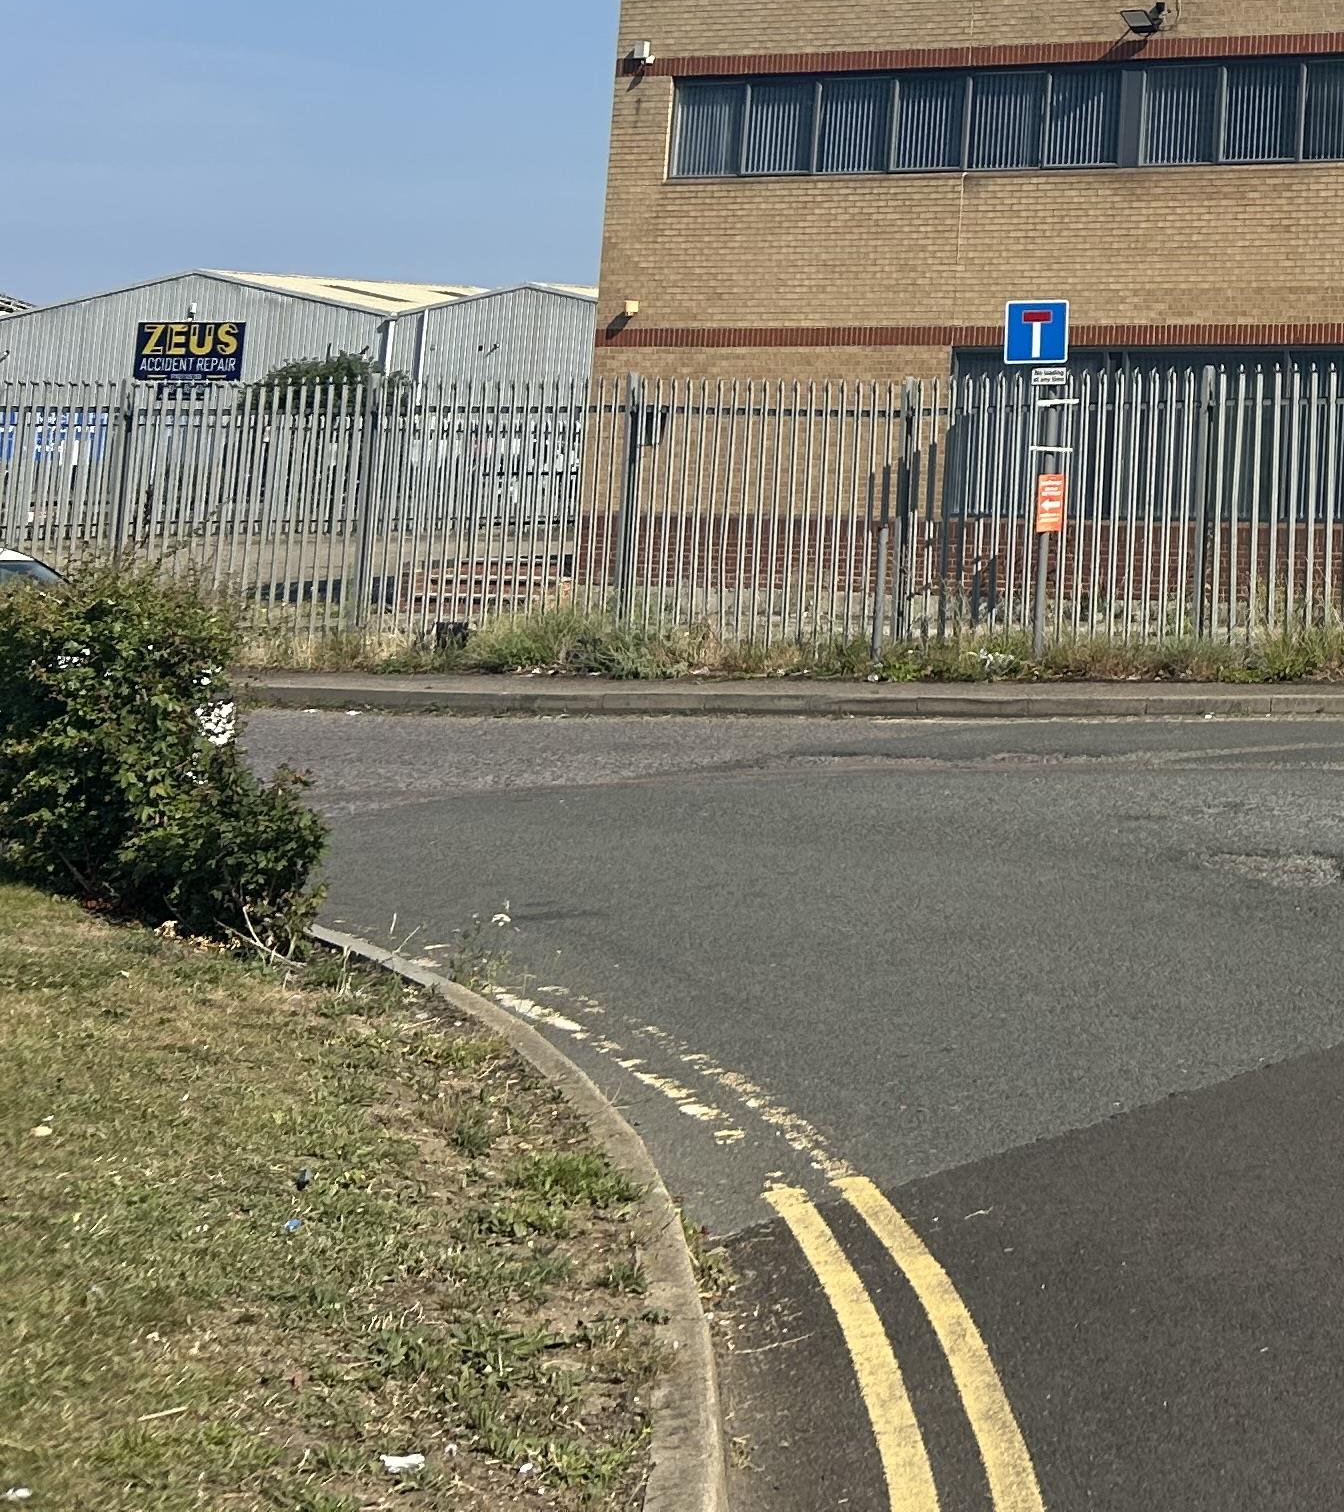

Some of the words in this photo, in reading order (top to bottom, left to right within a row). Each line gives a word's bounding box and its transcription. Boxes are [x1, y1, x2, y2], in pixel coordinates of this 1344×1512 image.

[142, 323, 239, 356] ZEUS
[140, 357, 195, 372] ACCIDENT
[196, 357, 237, 372] REPAIR
